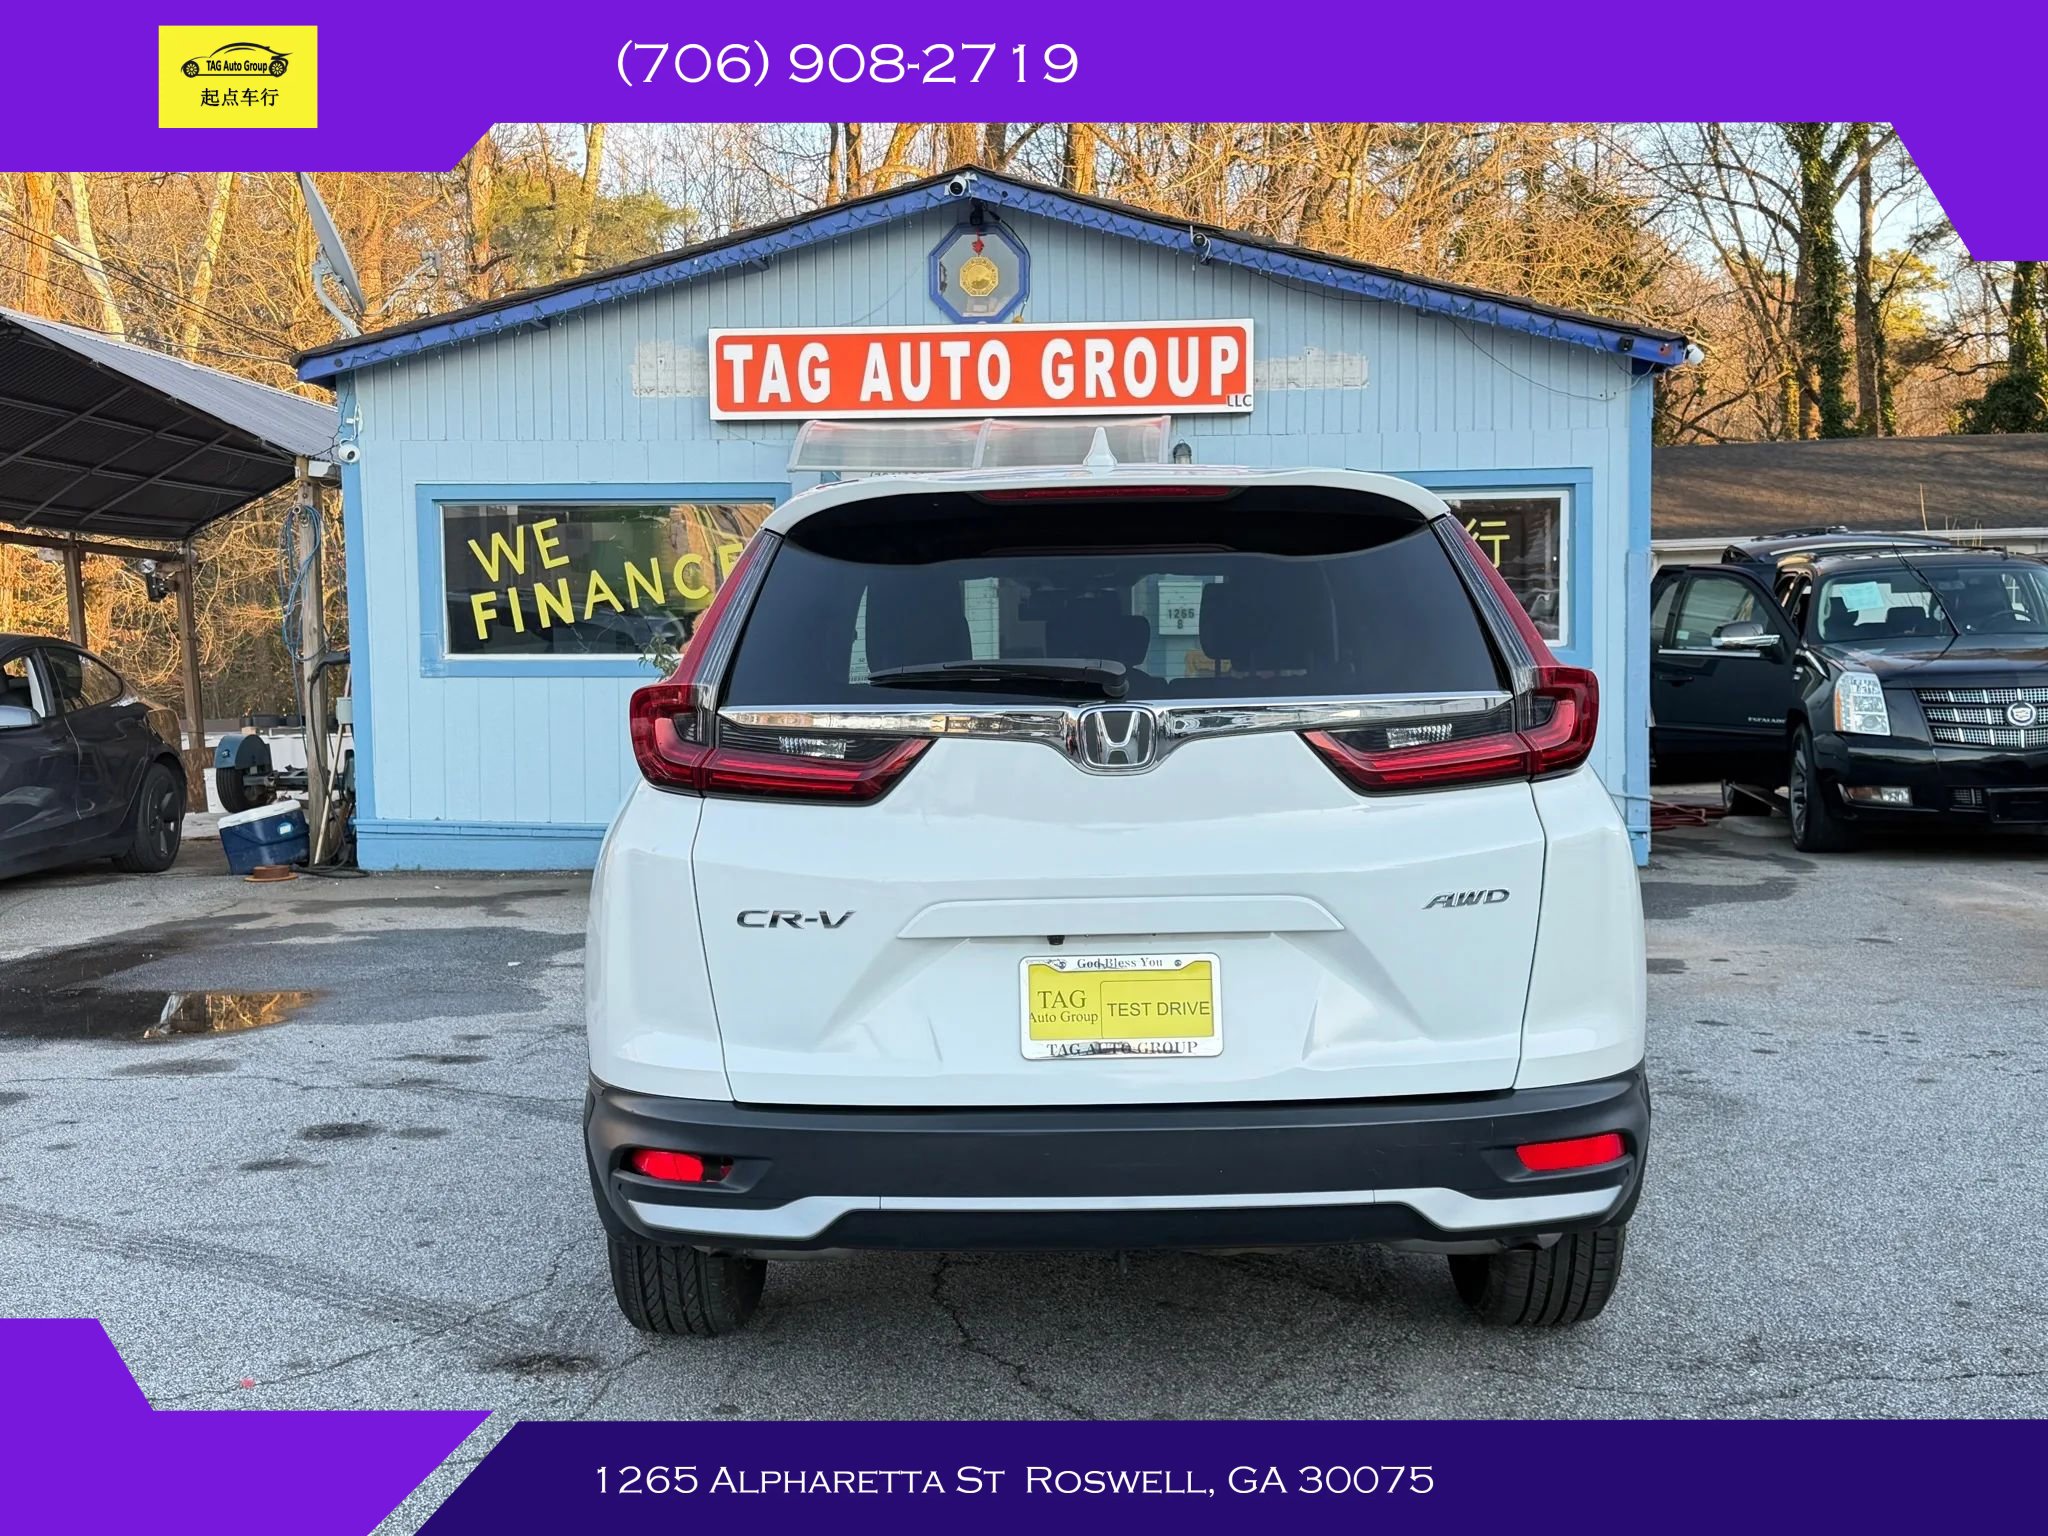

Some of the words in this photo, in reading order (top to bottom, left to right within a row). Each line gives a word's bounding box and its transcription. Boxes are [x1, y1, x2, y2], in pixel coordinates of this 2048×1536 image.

[722, 342, 831, 404] TAG
[859, 339, 1011, 402] AUTO
[1041, 335, 1239, 400] GROUP
[1226, 394, 1252, 407] LLC
[467, 518, 570, 582] WE
[1168, 608, 1195, 619] 1265
[1421, 888, 1510, 910] AWD
[736, 909, 857, 930] CR-V
[1077, 958, 1101, 969] God
[1105, 957, 1137, 969] Bless
[1140, 957, 1163, 968] You
[1037, 989, 1087, 1009] TAG
[1029, 1011, 1057, 1023] Auto
[1060, 1010, 1099, 1024] Group
[1107, 1002, 1152, 1017] TEST
[1157, 1001, 1210, 1016] DRIVE
[1047, 1043, 1081, 1057] TAG
[1137, 1041, 1198, 1055] GROUP
